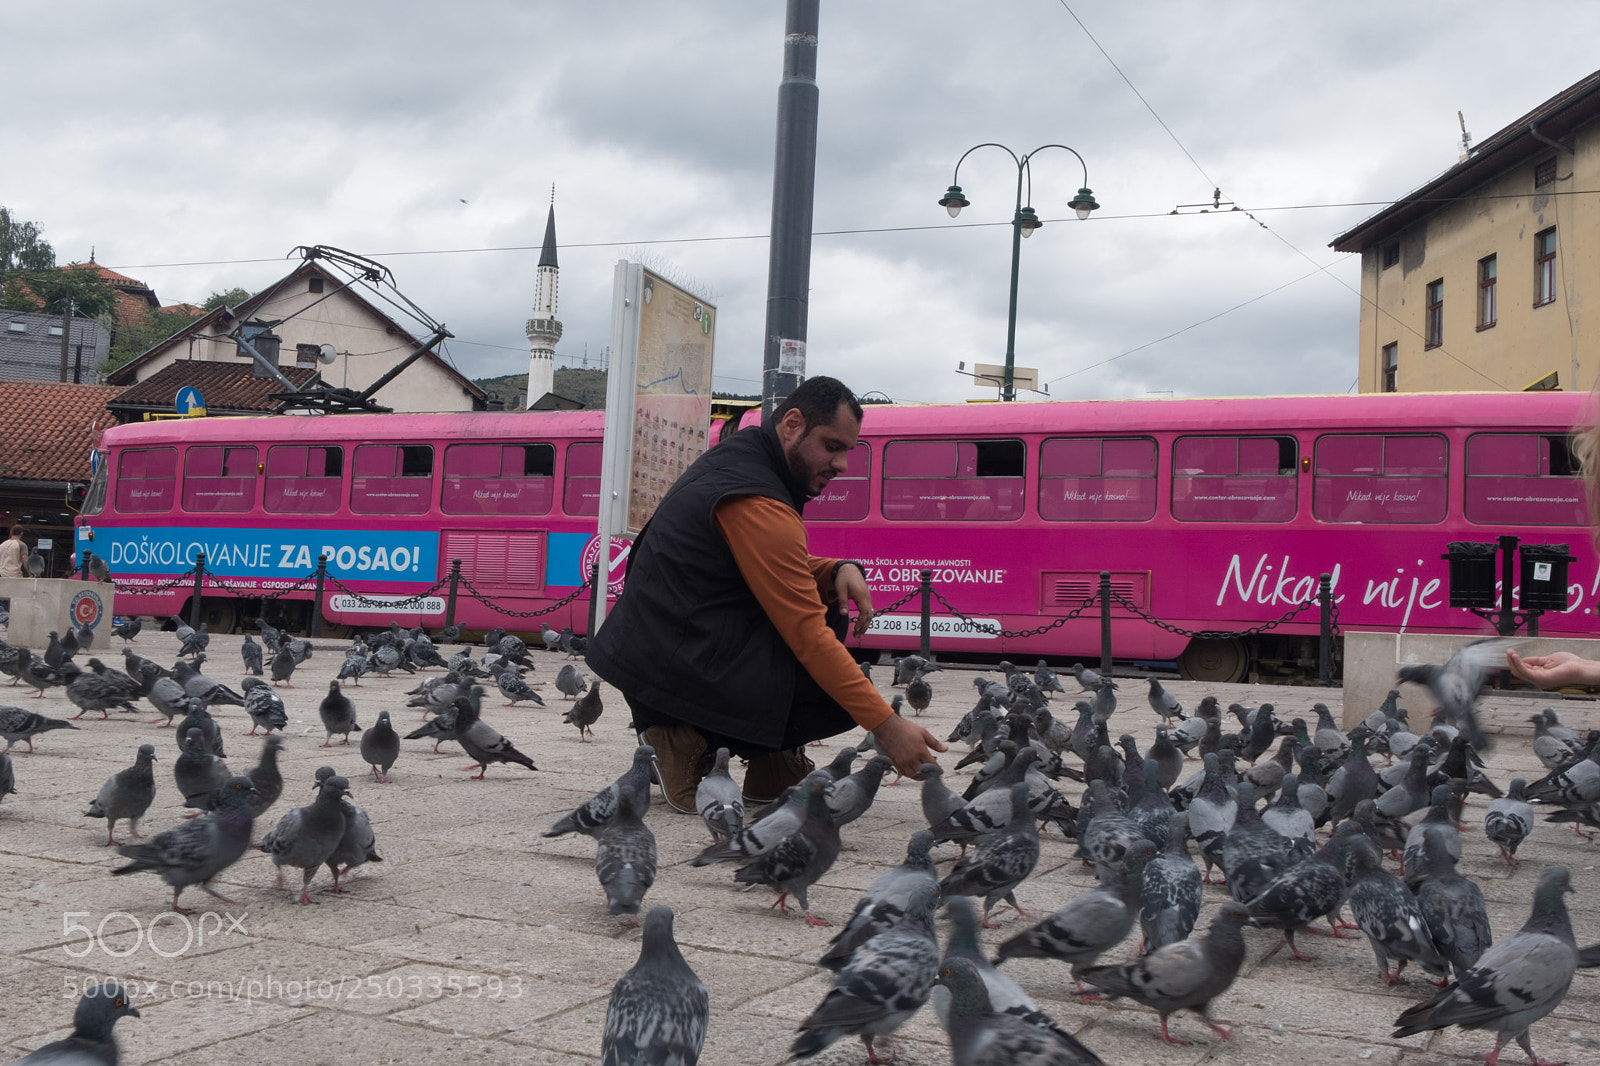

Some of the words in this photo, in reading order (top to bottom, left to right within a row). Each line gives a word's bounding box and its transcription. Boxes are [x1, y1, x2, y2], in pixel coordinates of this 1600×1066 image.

[1346, 490, 1372, 501] Nikad
[1374, 491, 1391, 505] nije
[1393, 489, 1421, 502] kasno!
[111, 535, 271, 568] DOŠKOLOVANJE
[277, 544, 313, 569] ZA
[321, 545, 420, 573] POSAO!
[875, 557, 899, 566] ŠKOLA
[906, 559, 936, 567] PRAVOM
[937, 559, 971, 567] JAVNOSTI
[864, 568, 885, 582] ZA
[889, 568, 1003, 584] OBRZOVANJE
[879, 584, 901, 592] CESTA
[1362, 559, 1443, 633] nije
[342, 599, 356, 608] 033
[426, 601, 441, 610] 888
[883, 620, 902, 631] 208
[932, 622, 951, 632] 062
[953, 623, 973, 633] 000
